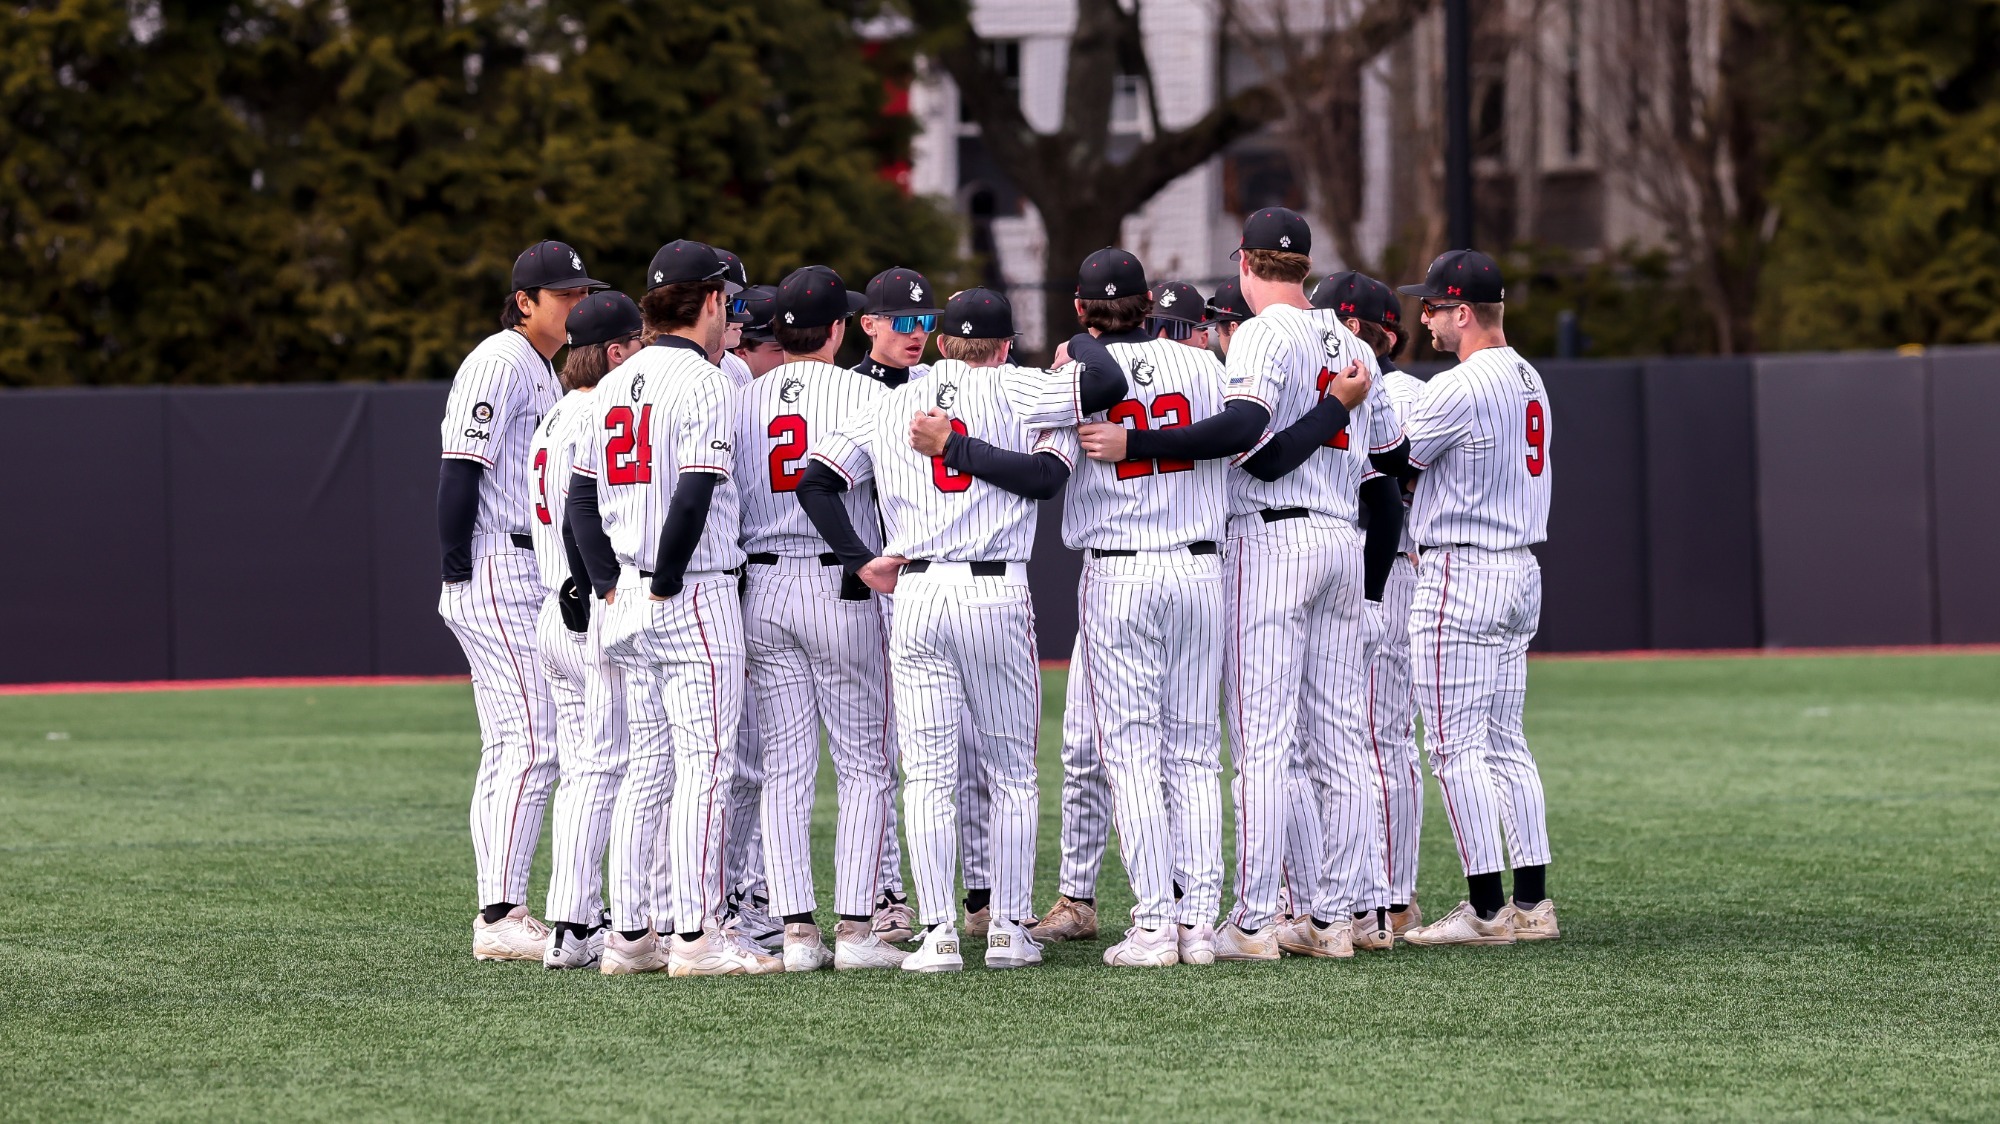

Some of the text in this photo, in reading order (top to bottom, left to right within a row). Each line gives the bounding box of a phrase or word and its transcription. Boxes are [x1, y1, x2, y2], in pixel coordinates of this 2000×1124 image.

[464, 428, 490, 442] CAA
[604, 403, 652, 486] 24
[768, 413, 808, 493] 2
[1525, 400, 1545, 477] 9
[534, 447, 552, 525] 3
